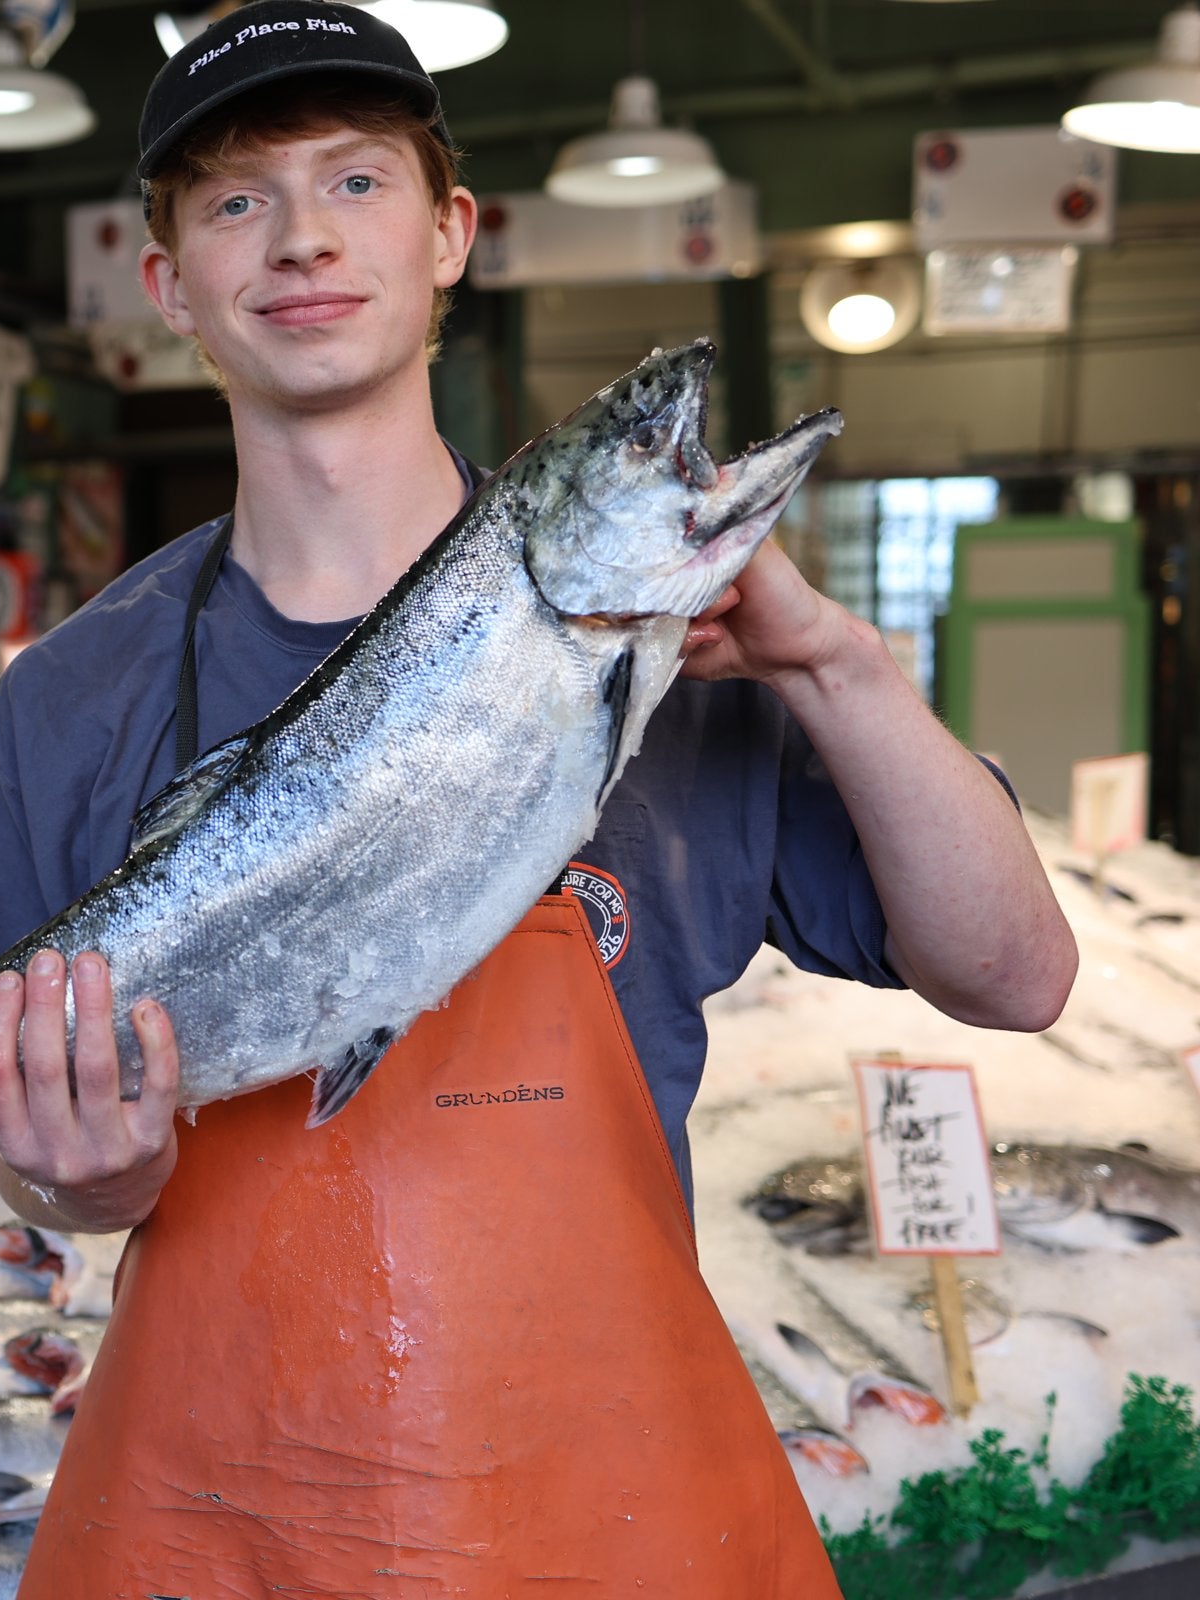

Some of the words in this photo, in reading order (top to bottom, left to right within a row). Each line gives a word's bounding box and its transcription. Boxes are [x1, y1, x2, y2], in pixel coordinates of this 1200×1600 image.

[187, 41, 233, 76] Pike
[235, 21, 300, 46] Place
[305, 18, 357, 35] Fish
[588, 880, 612, 902] FOR
[608, 897, 623, 915] MS
[611, 914, 624, 925] WA
[600, 934, 622, 961] 026
